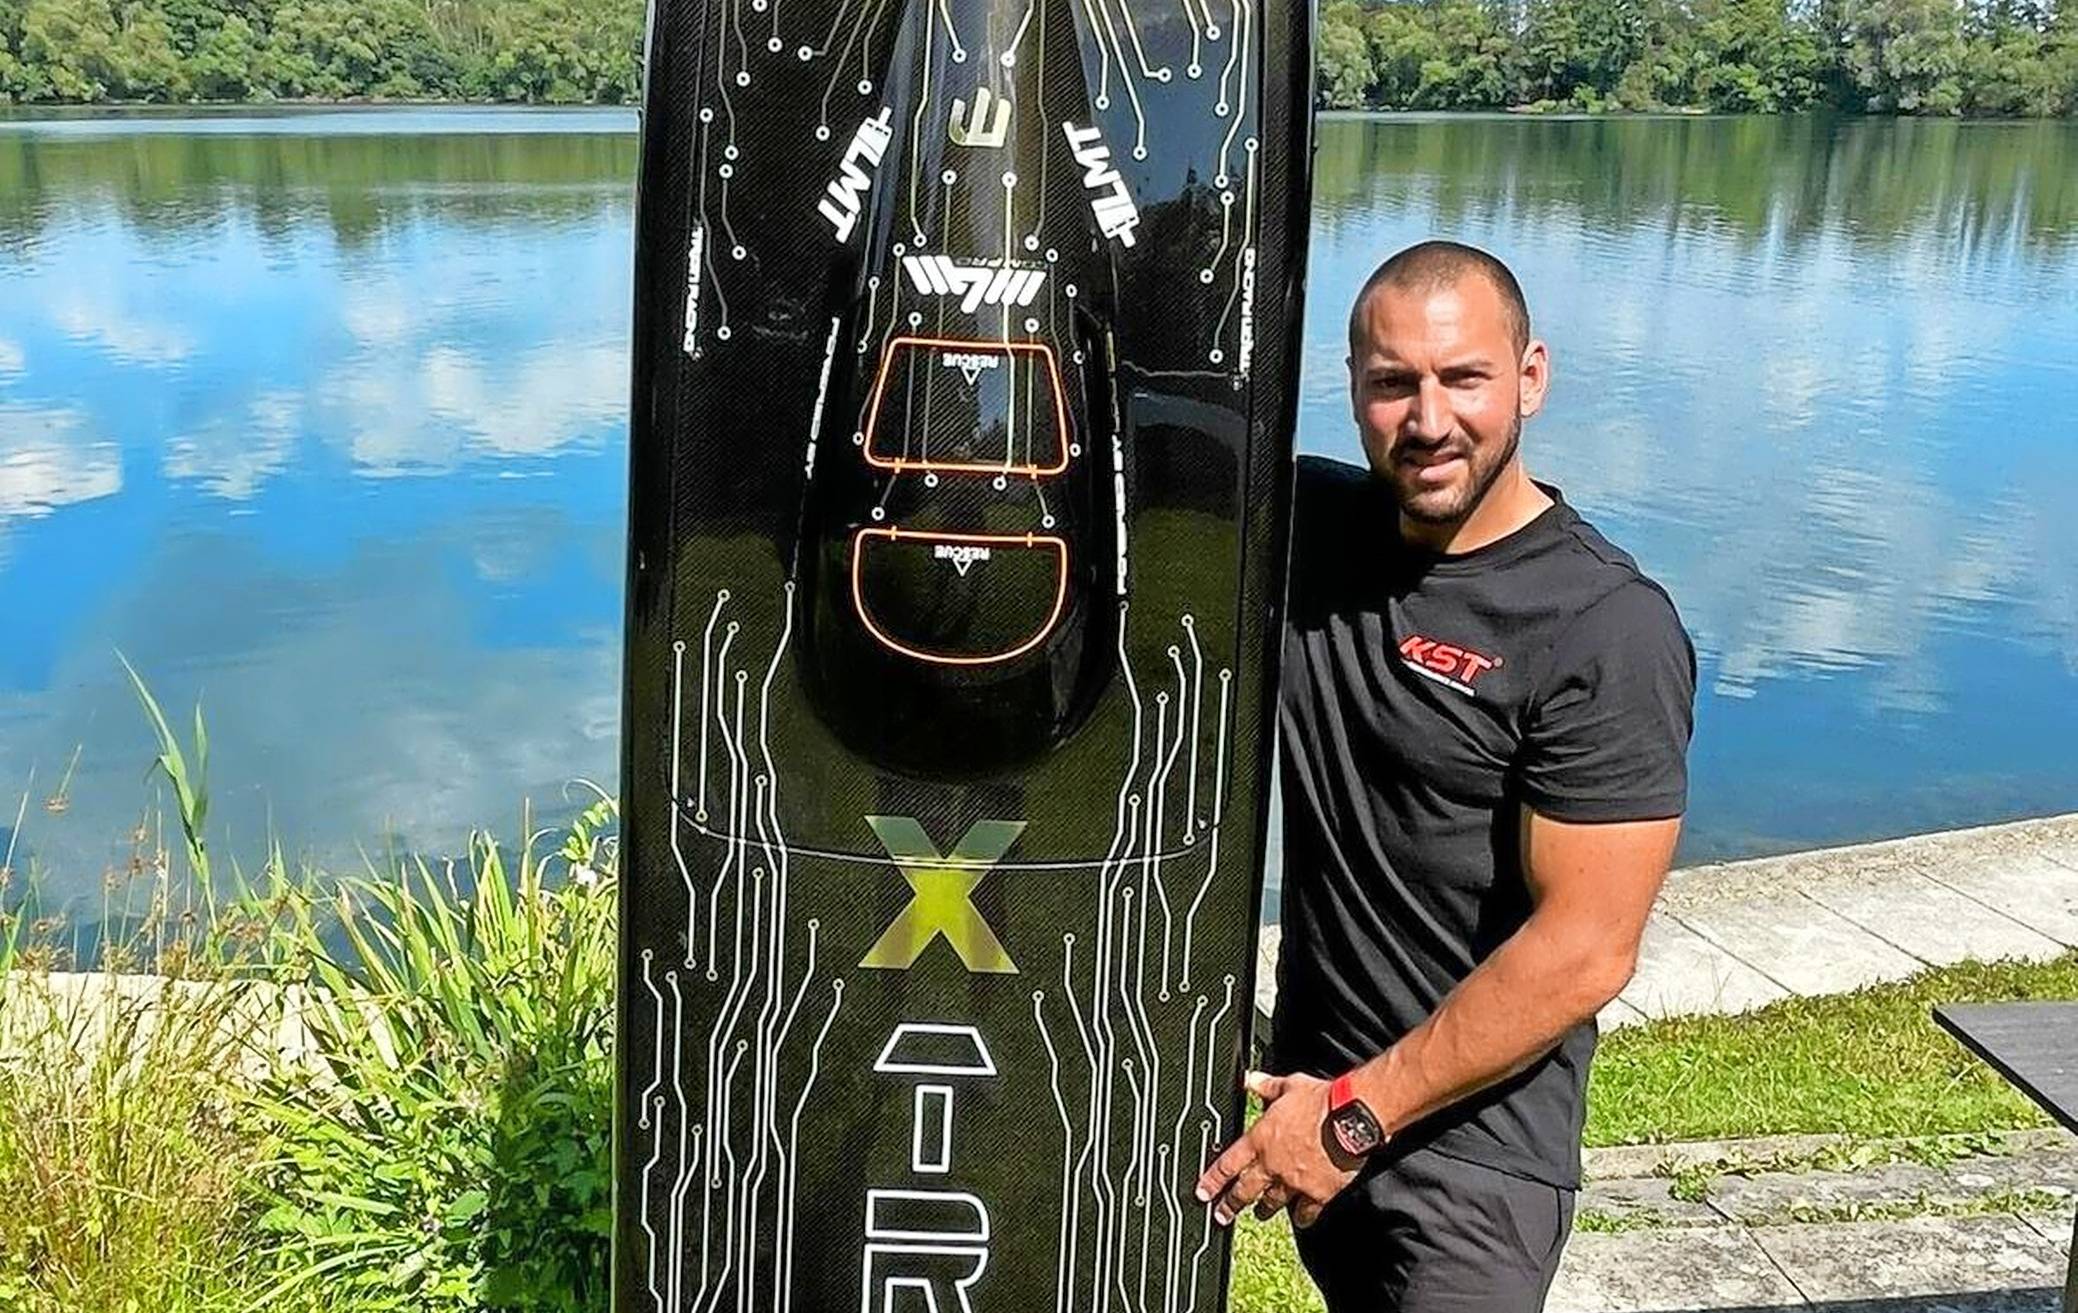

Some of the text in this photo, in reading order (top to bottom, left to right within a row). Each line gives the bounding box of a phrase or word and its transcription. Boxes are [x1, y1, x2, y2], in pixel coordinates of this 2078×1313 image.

[942, 353, 999, 370] RESCUE
[934, 545, 990, 562] RESCUE
[1399, 635, 1493, 684] KST
[857, 814, 1028, 975] X
